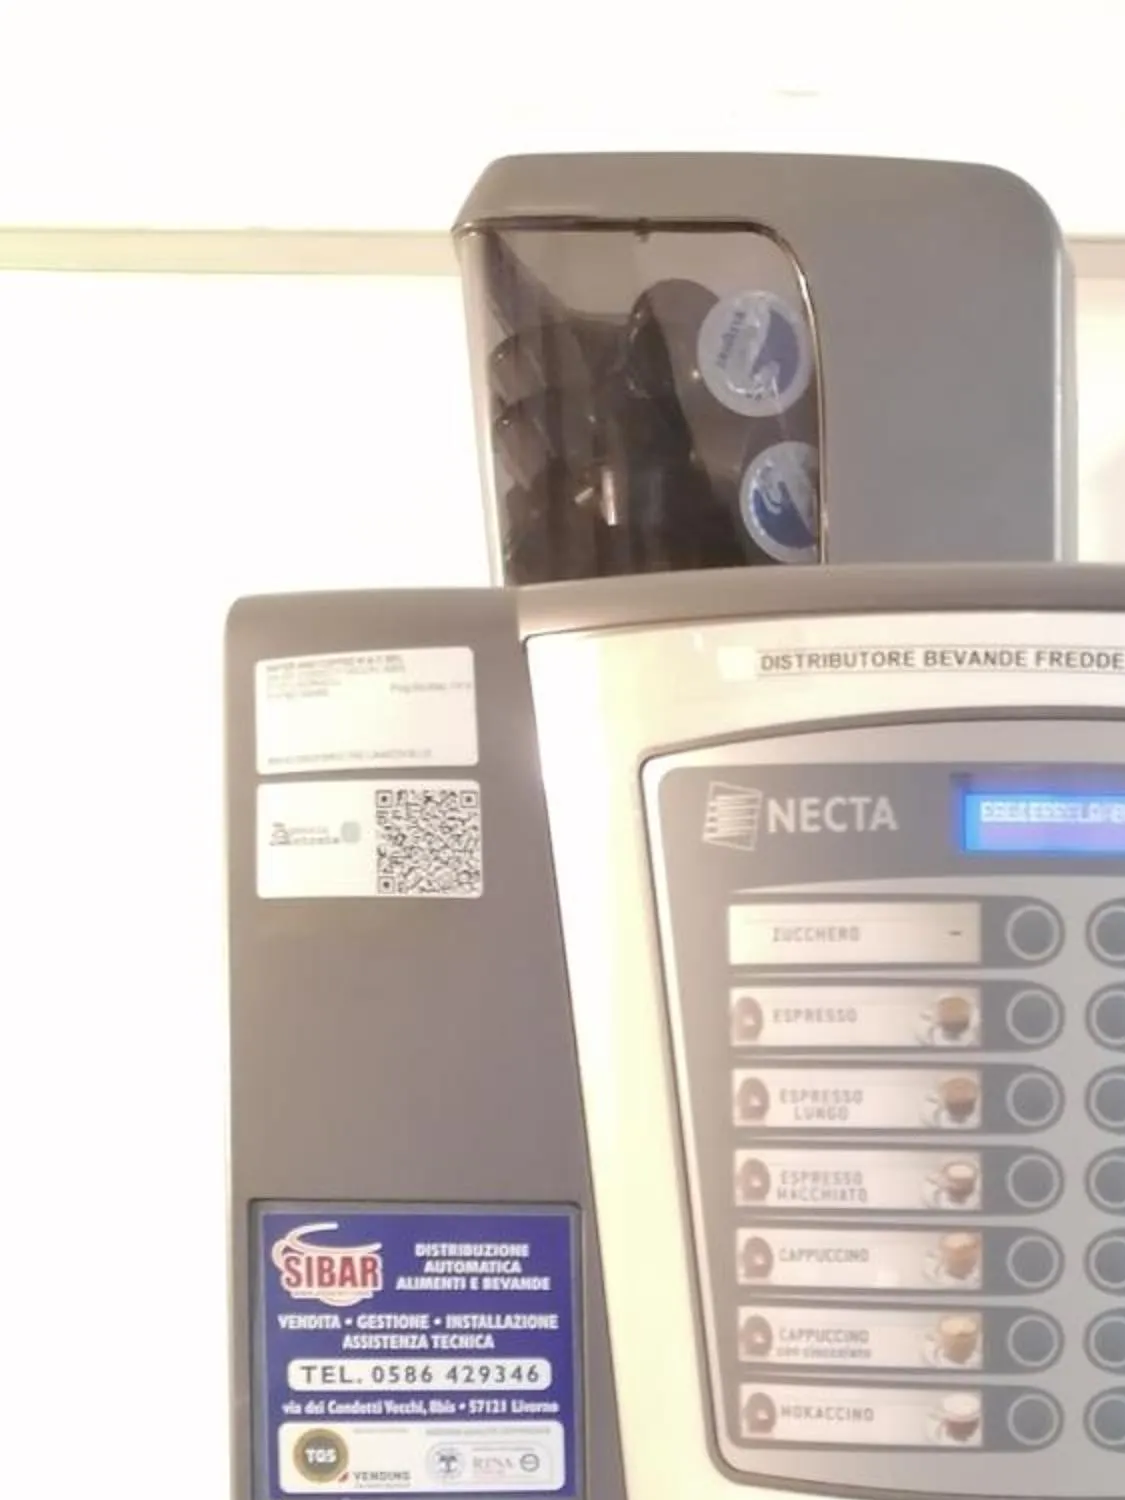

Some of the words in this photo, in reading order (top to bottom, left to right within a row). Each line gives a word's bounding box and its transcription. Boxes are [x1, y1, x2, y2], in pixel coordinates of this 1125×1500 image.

[760, 650, 916, 672] DISTRIBUTORE
[923, 649, 1027, 669] BEVANDE
[1035, 650, 1125, 670] FREDDE
[767, 797, 898, 833] NECTA
[772, 926, 860, 943] ZUCCHERO
[772, 1008, 858, 1024] ESPRESSO
[779, 1088, 864, 1105] ESPRESSO
[793, 1106, 849, 1121] LUNGO
[779, 1170, 864, 1186] ESPRESSO
[777, 1187, 868, 1203] MACCHIATO
[414, 1243, 530, 1258] DISTRIBUZIONE
[779, 1248, 870, 1264] CAPPUCCINO
[283, 1254, 380, 1289] SIBAR
[423, 1260, 522, 1274] AUTOMATICA
[396, 1276, 467, 1291] ALIMENTI
[470, 1276, 479, 1291] E
[482, 1276, 551, 1291] BEVANDE
[278, 1314, 341, 1330] VENDITA
[356, 1314, 430, 1330] GESTIONE
[445, 1314, 559, 1330] INSTALLAZIONE
[342, 1334, 429, 1349] ASSISTENZA
[431, 1334, 495, 1349] TECNICA
[779, 1329, 870, 1344] CAPPUCCINO
[301, 1364, 364, 1385] TEL.
[371, 1364, 434, 1384] 0586
[445, 1364, 540, 1384] 429346
[281, 1399, 301, 1415] via
[780, 1404, 875, 1422] MOKACCINO
